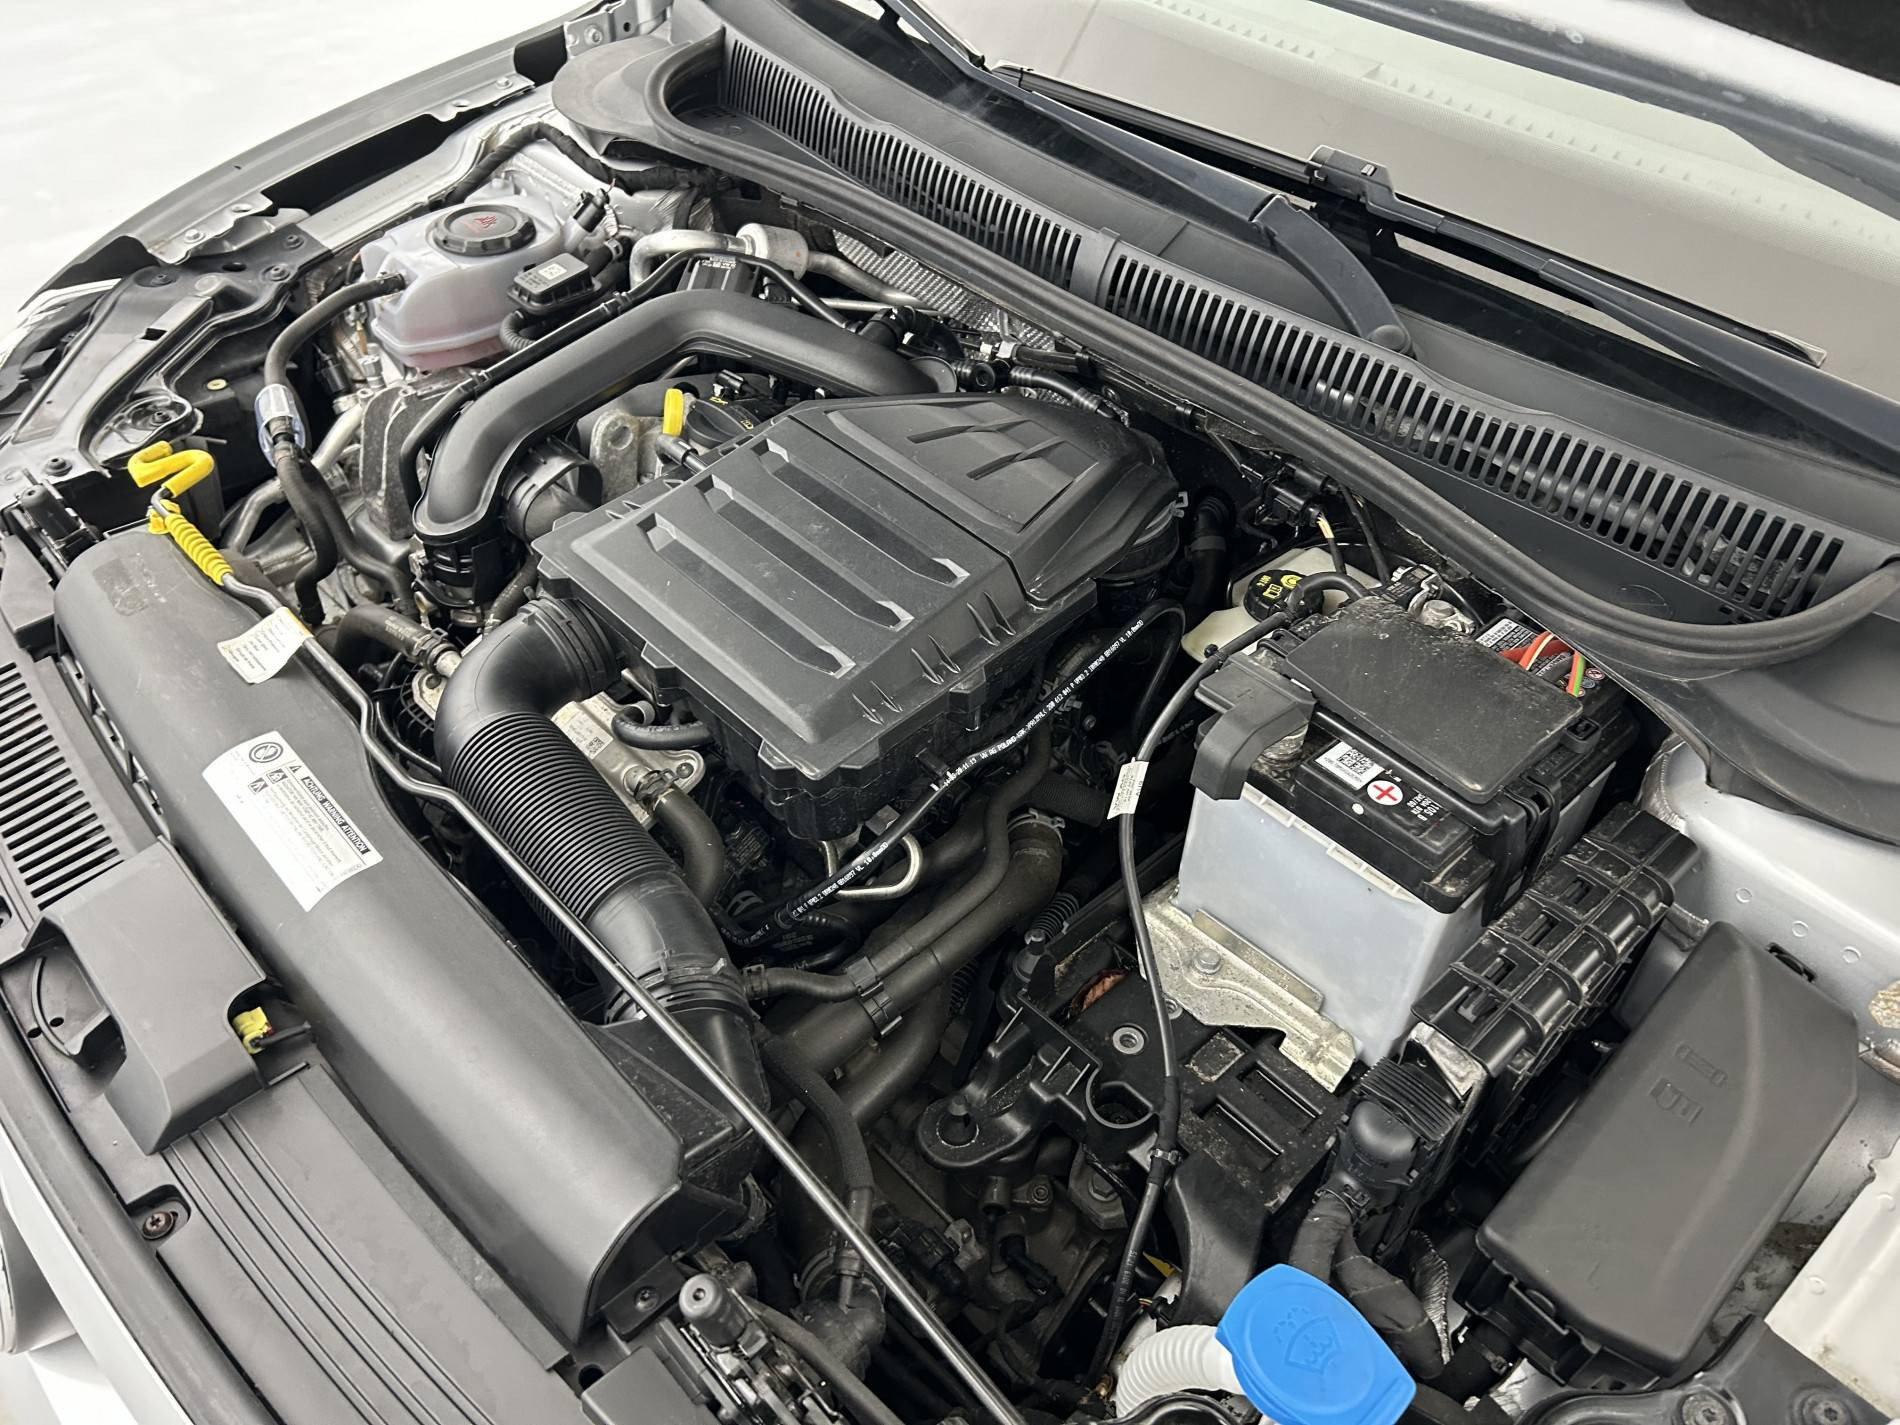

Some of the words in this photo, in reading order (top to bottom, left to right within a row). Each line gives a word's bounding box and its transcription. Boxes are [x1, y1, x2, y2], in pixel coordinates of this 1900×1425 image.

[303, 776, 324, 801] ACHTUNG
[322, 800, 344, 824] WARNING
[340, 823, 366, 852] ATTENTION
